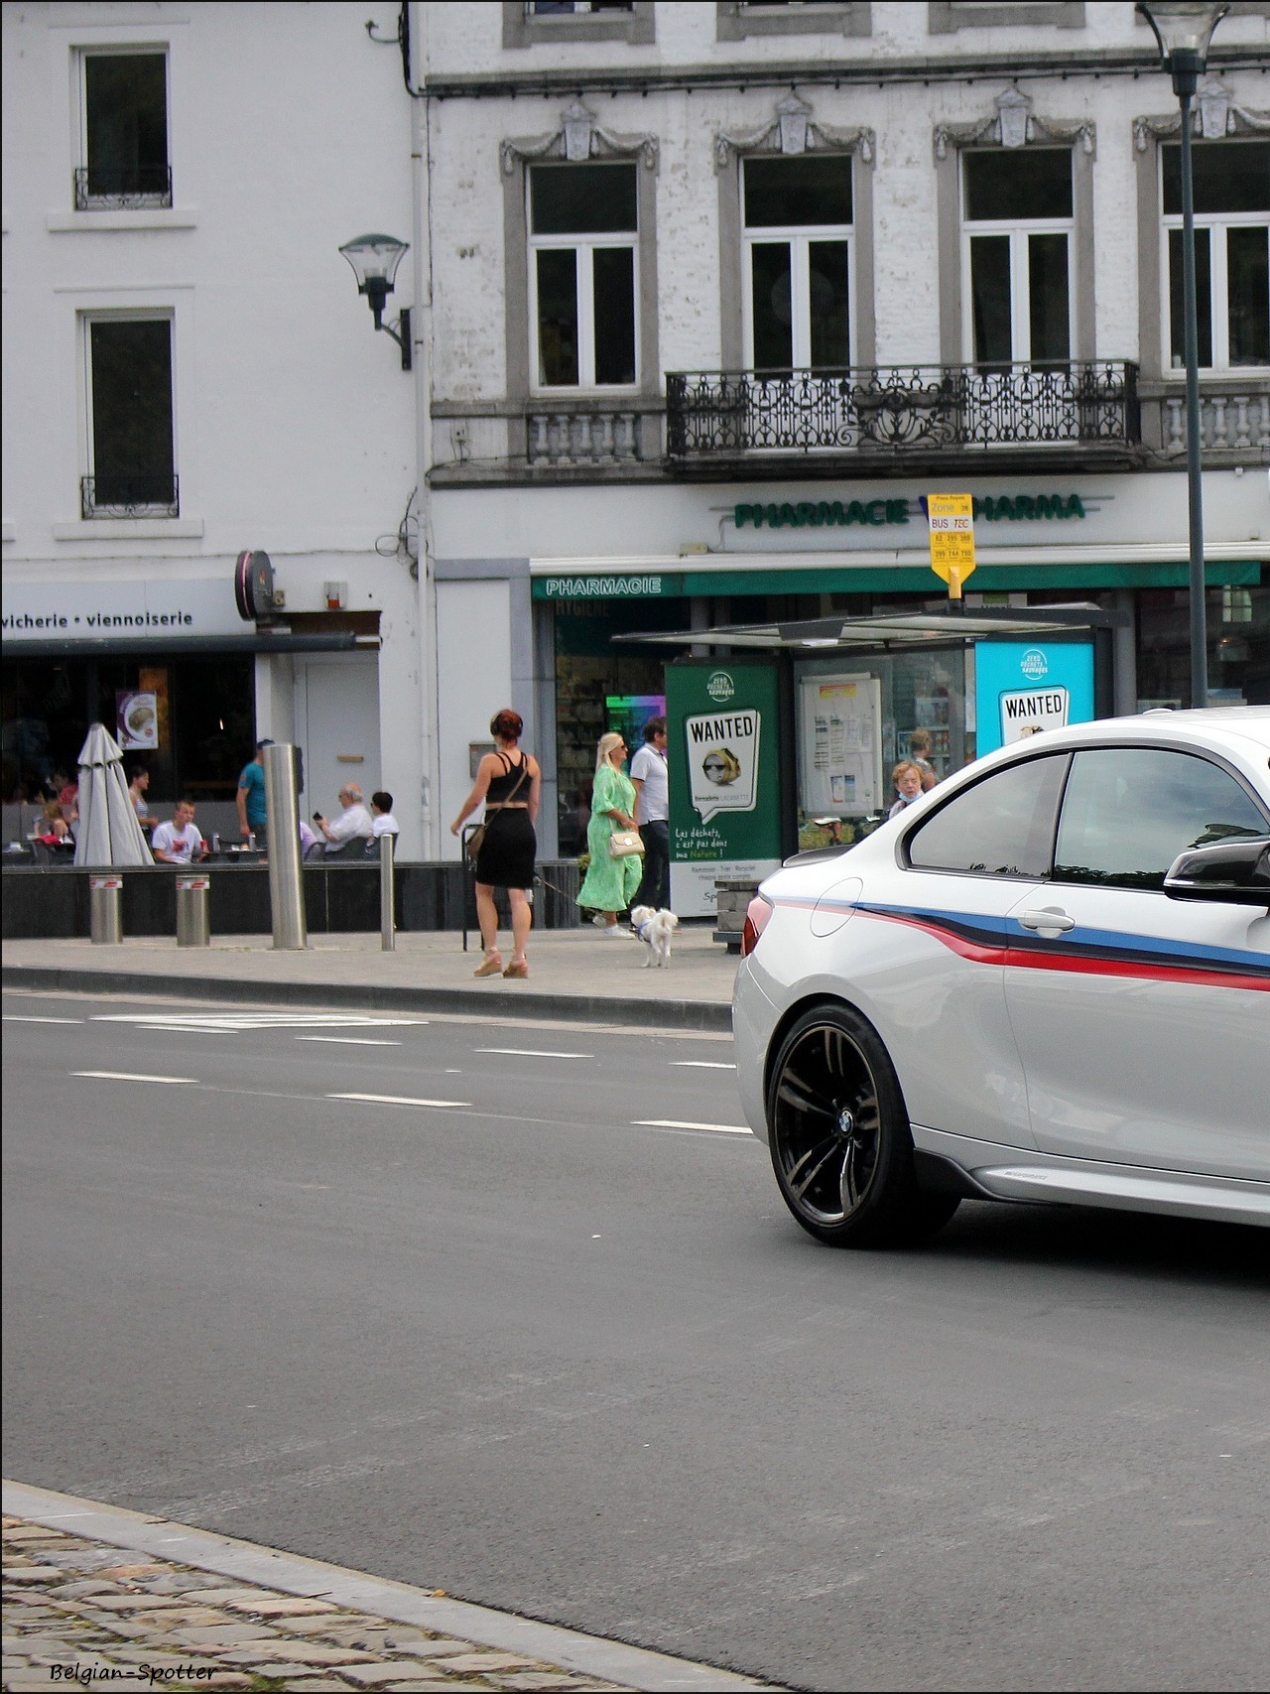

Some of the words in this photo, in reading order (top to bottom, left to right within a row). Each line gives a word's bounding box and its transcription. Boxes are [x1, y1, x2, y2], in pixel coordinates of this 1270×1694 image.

[735, 498, 909, 529] PHARMACIE
[971, 493, 1086, 522] HARMA
[931, 502, 954, 512] Zone
[932, 519, 949, 529] BUS
[954, 519, 969, 528] TEC
[546, 577, 662, 596] PHARMACIE
[87, 611, 193, 627] viennoiserie
[1006, 694, 1062, 718] WANTED
[690, 716, 753, 743] WANTED
[675, 828, 688, 838] Les
[696, 840, 709, 849] pas
[703, 892, 717, 903] Sp
